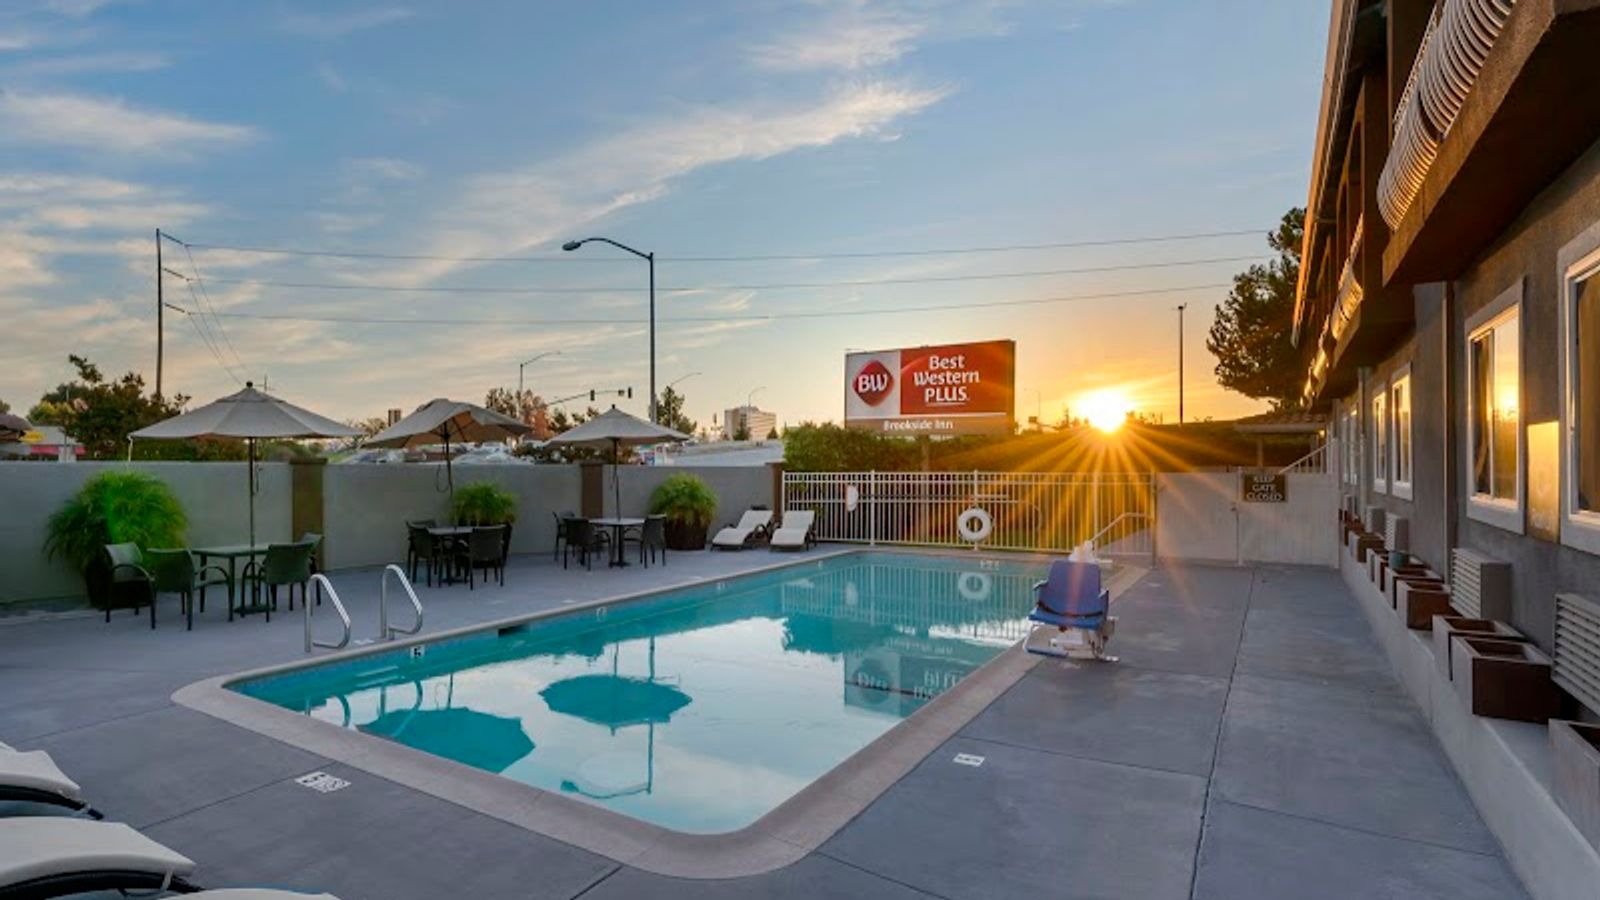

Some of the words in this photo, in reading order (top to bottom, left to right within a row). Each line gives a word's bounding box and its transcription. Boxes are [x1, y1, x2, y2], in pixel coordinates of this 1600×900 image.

[928, 354, 966, 370] Best
[857, 373, 889, 393] BW
[913, 370, 981, 386] Western
[924, 386, 968, 402] PLUS
[883, 420, 932, 431] Brookside
[935, 420, 954, 430] Inn
[1252, 483, 1276, 492] GATE
[1246, 491, 1283, 502] CLOSED
